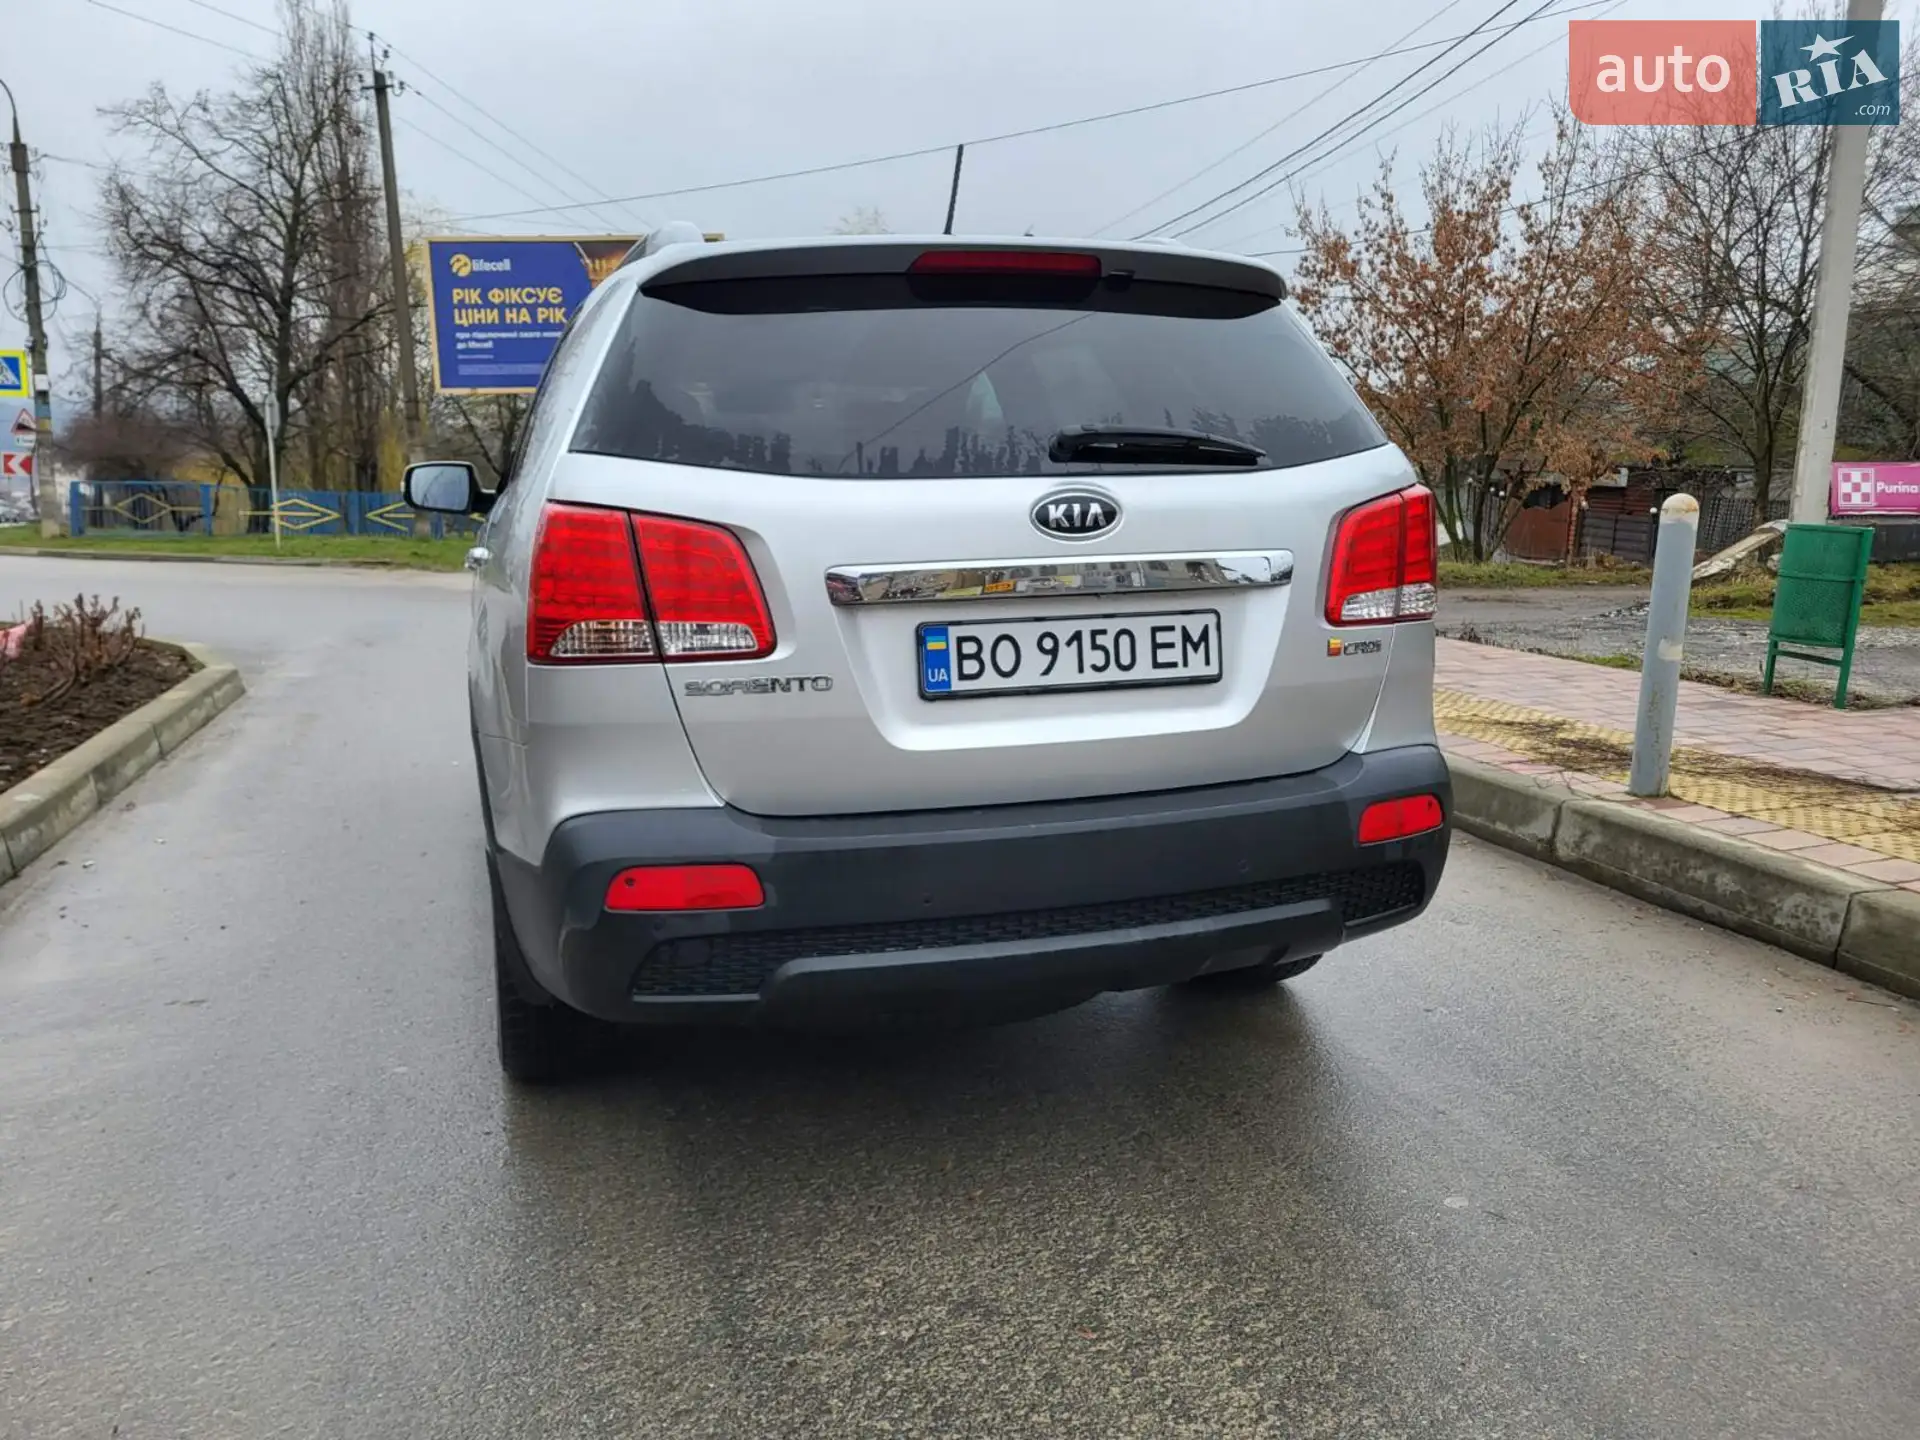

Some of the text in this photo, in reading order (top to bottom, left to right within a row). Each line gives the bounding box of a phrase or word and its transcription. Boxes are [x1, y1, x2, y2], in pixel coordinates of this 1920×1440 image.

[472, 258, 511, 271] lifecell
[452, 286, 563, 305] РІК ФІКСУЄ
[454, 306, 567, 327] ЦІНИ НА РІК
[1876, 481, 1919, 494] Purina
[1047, 502, 1107, 528] KIA
[956, 623, 1211, 681] BO 9150 EM
[684, 674, 833, 697] SORENTO
[928, 668, 949, 683] UA
